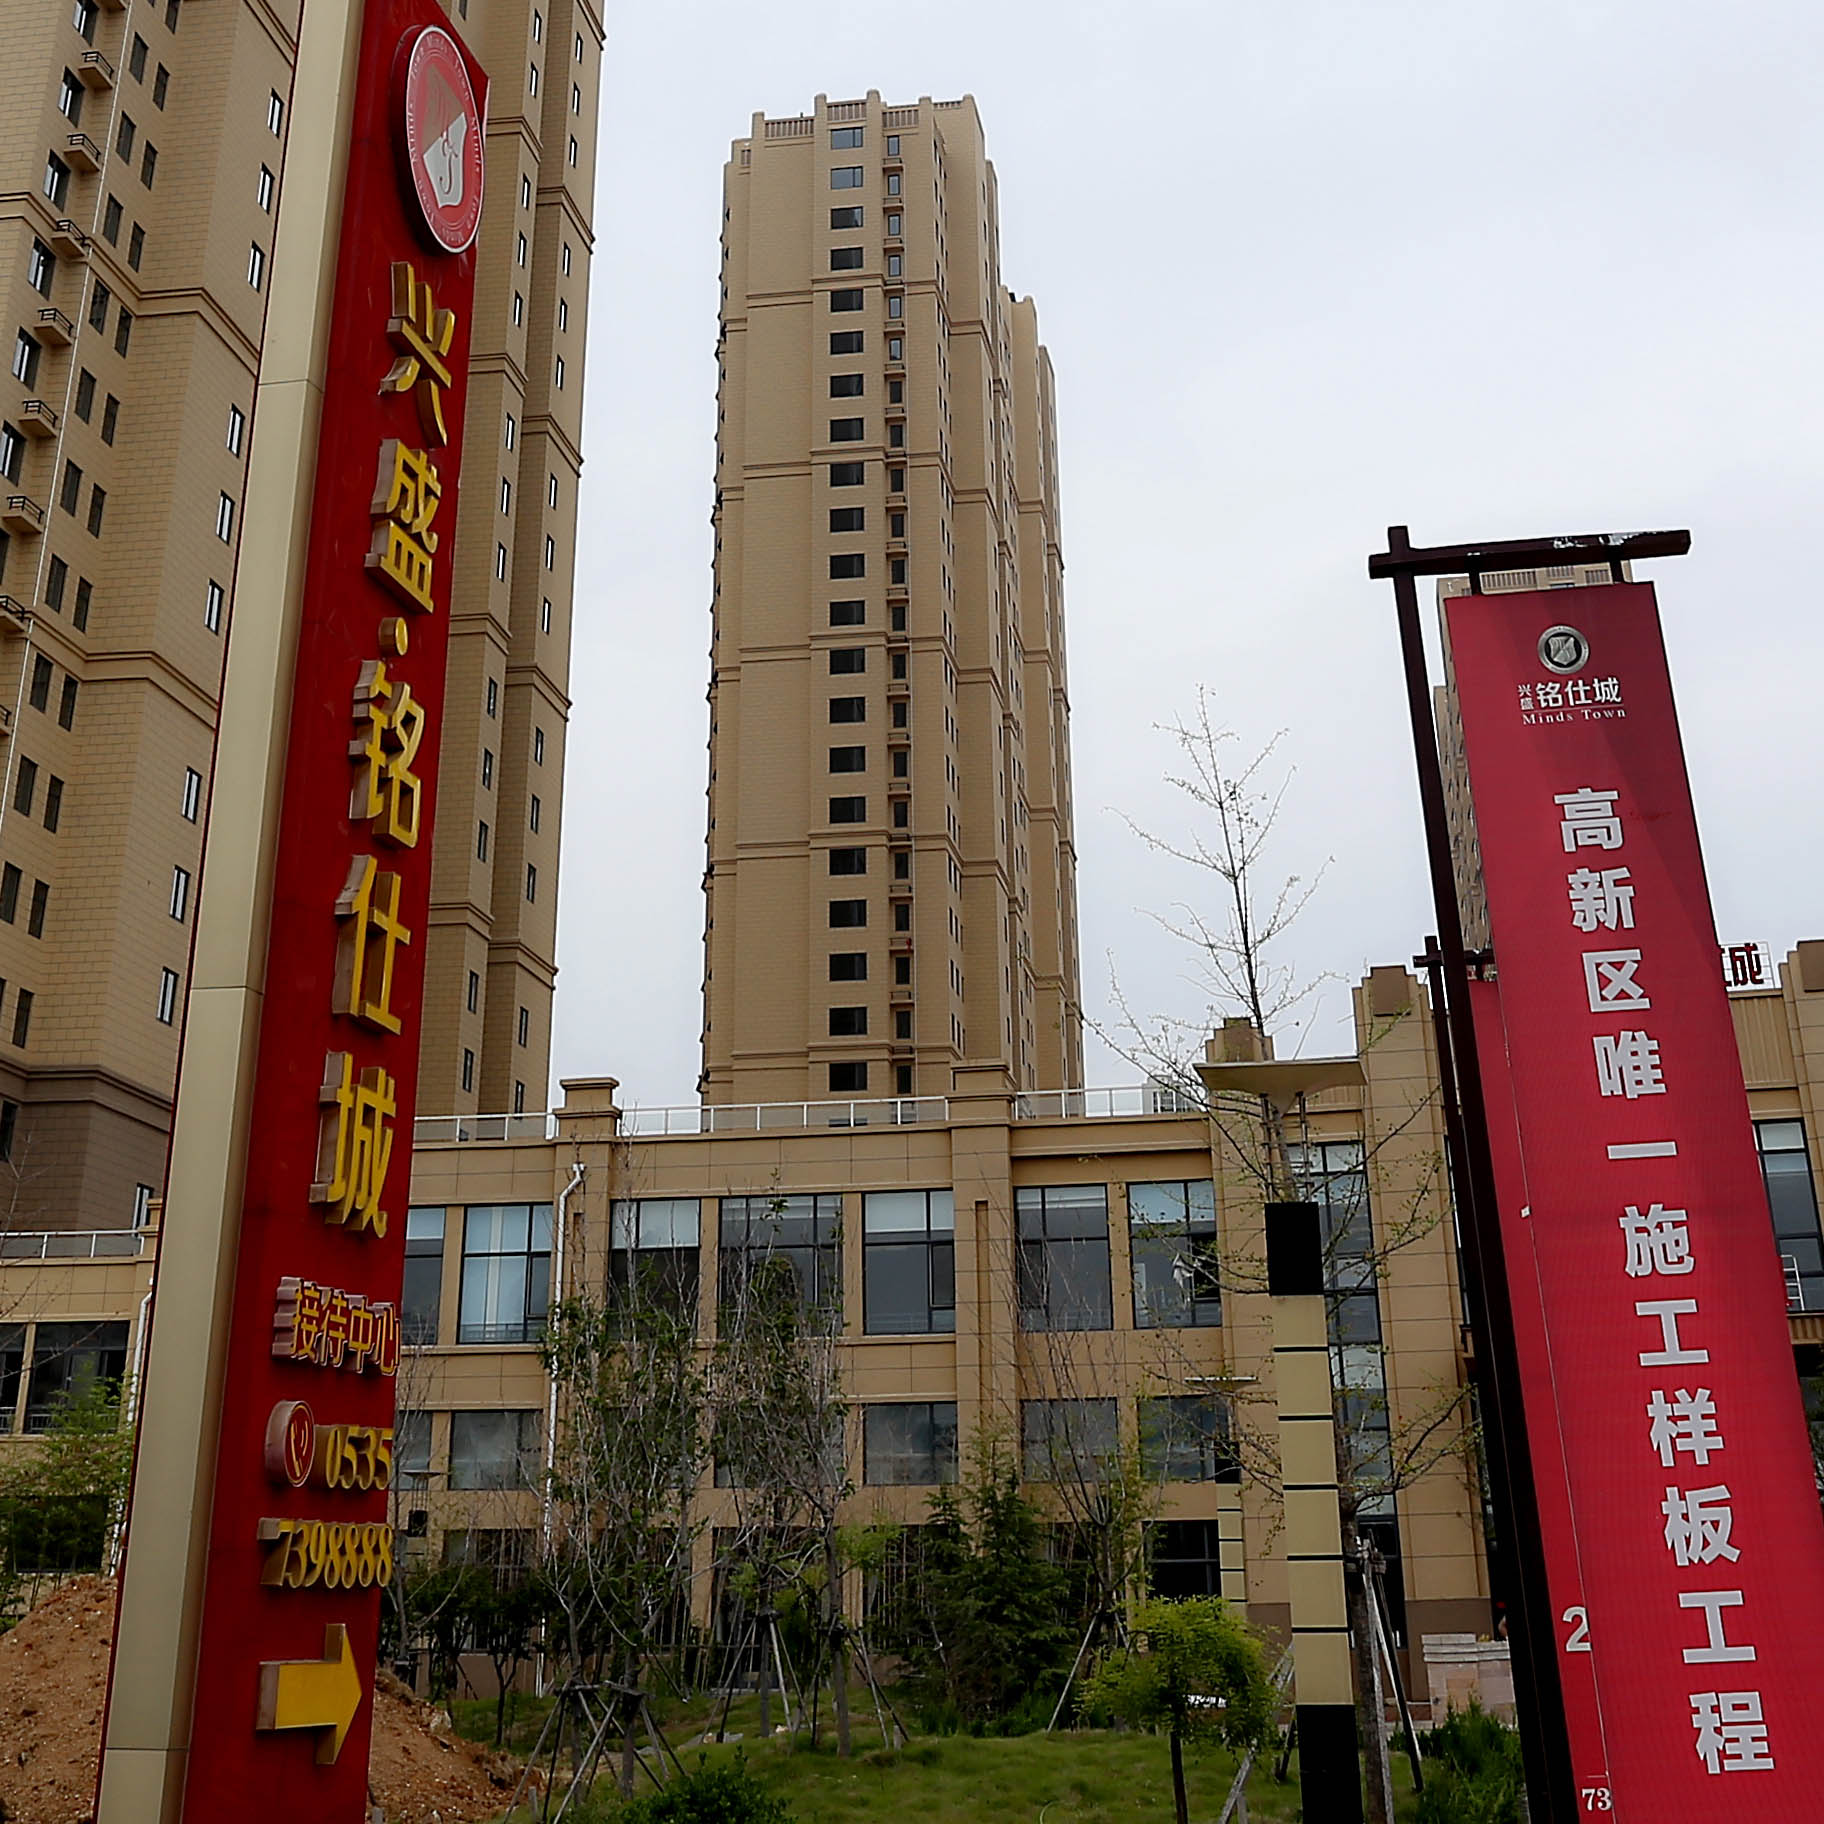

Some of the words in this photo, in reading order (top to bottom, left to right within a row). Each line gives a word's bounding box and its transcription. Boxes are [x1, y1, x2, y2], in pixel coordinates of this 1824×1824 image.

[1522, 711, 1574, 725] Minds
[1581, 709, 1626, 720] Town
[1535, 677, 1622, 708] 铭仕城
[1553, 787, 1775, 1776] 高新区唯一施工样板工程
[272, 1276, 400, 1376] 接待中心
[316, 1425, 393, 1490] 0535
[258, 1518, 393, 1589] 7398888
